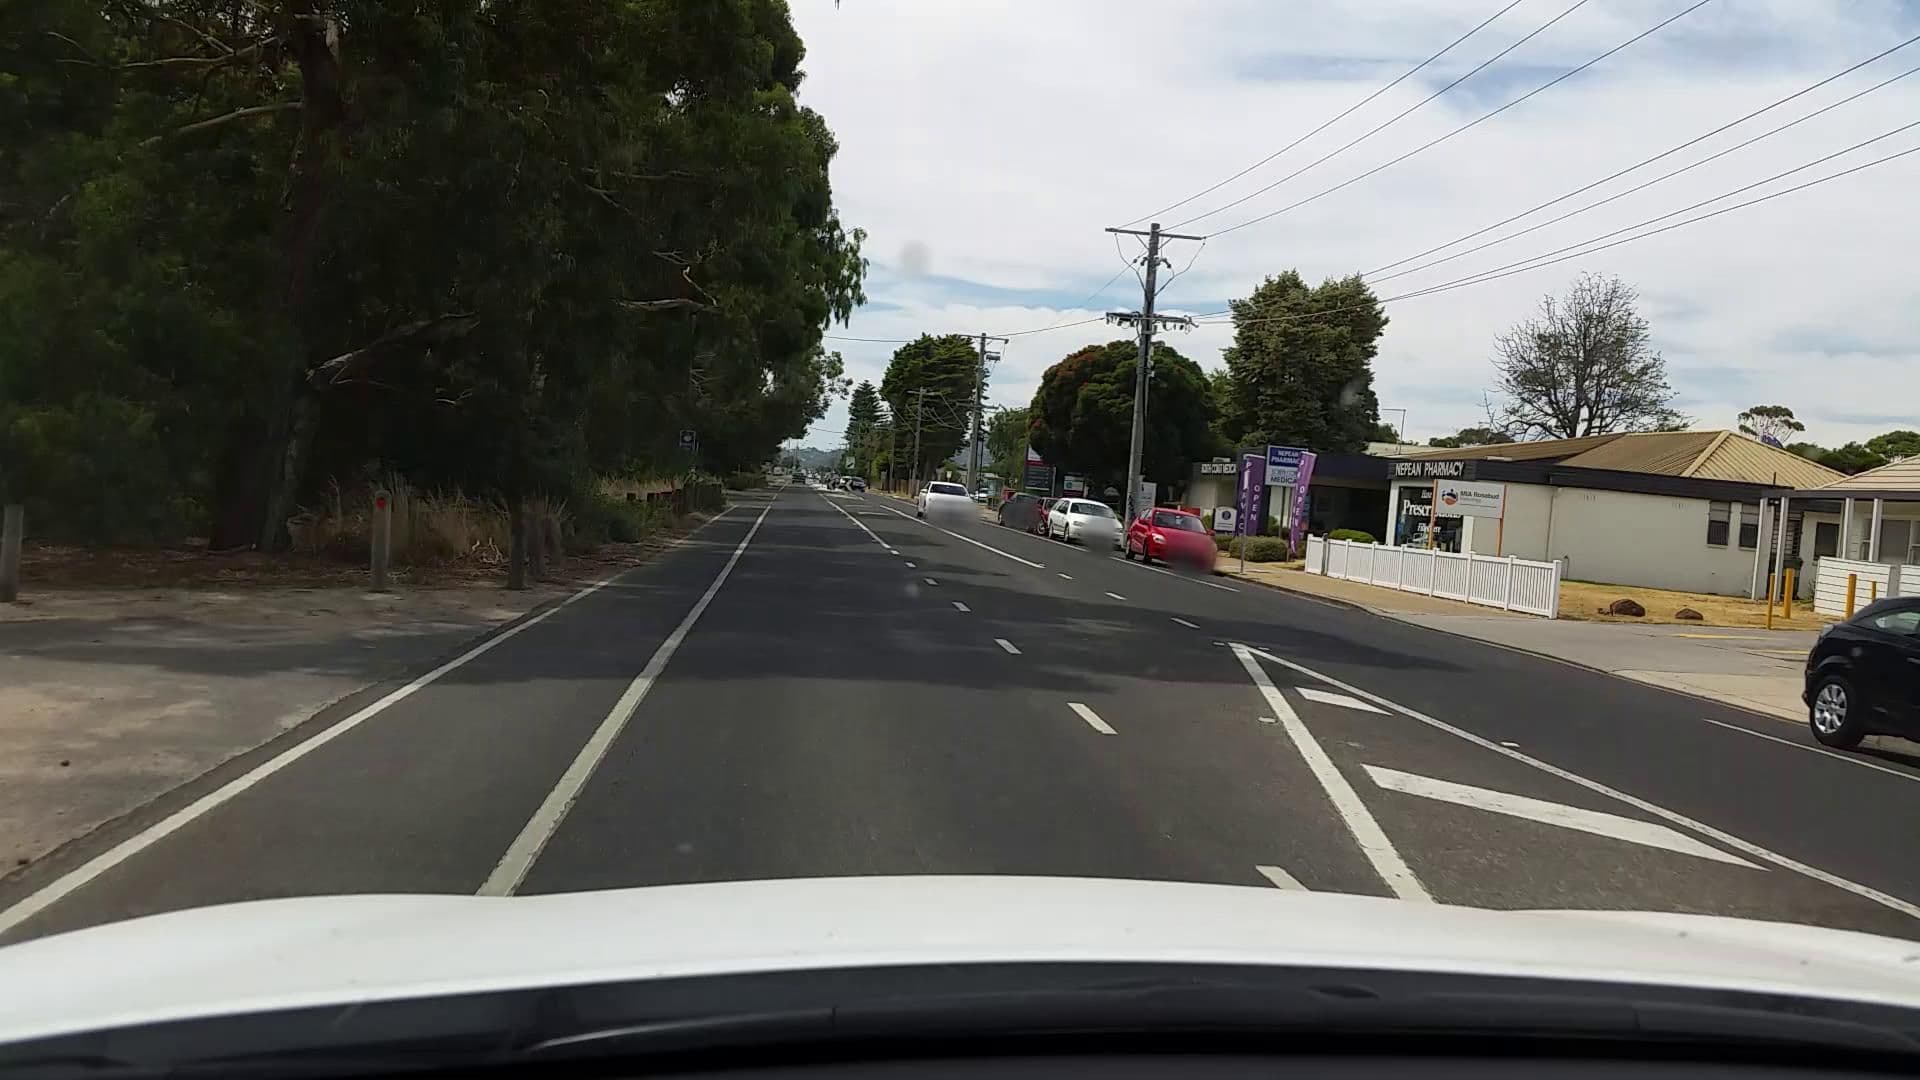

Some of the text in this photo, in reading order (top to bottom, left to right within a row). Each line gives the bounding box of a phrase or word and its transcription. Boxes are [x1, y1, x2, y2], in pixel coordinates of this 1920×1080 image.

[1270, 456, 1300, 465] PHARMAC
[1395, 461, 1464, 477] NEPEAN PHARMACY
[1270, 476, 1298, 484] MEDICA
[1250, 485, 1260, 520] OPEN
